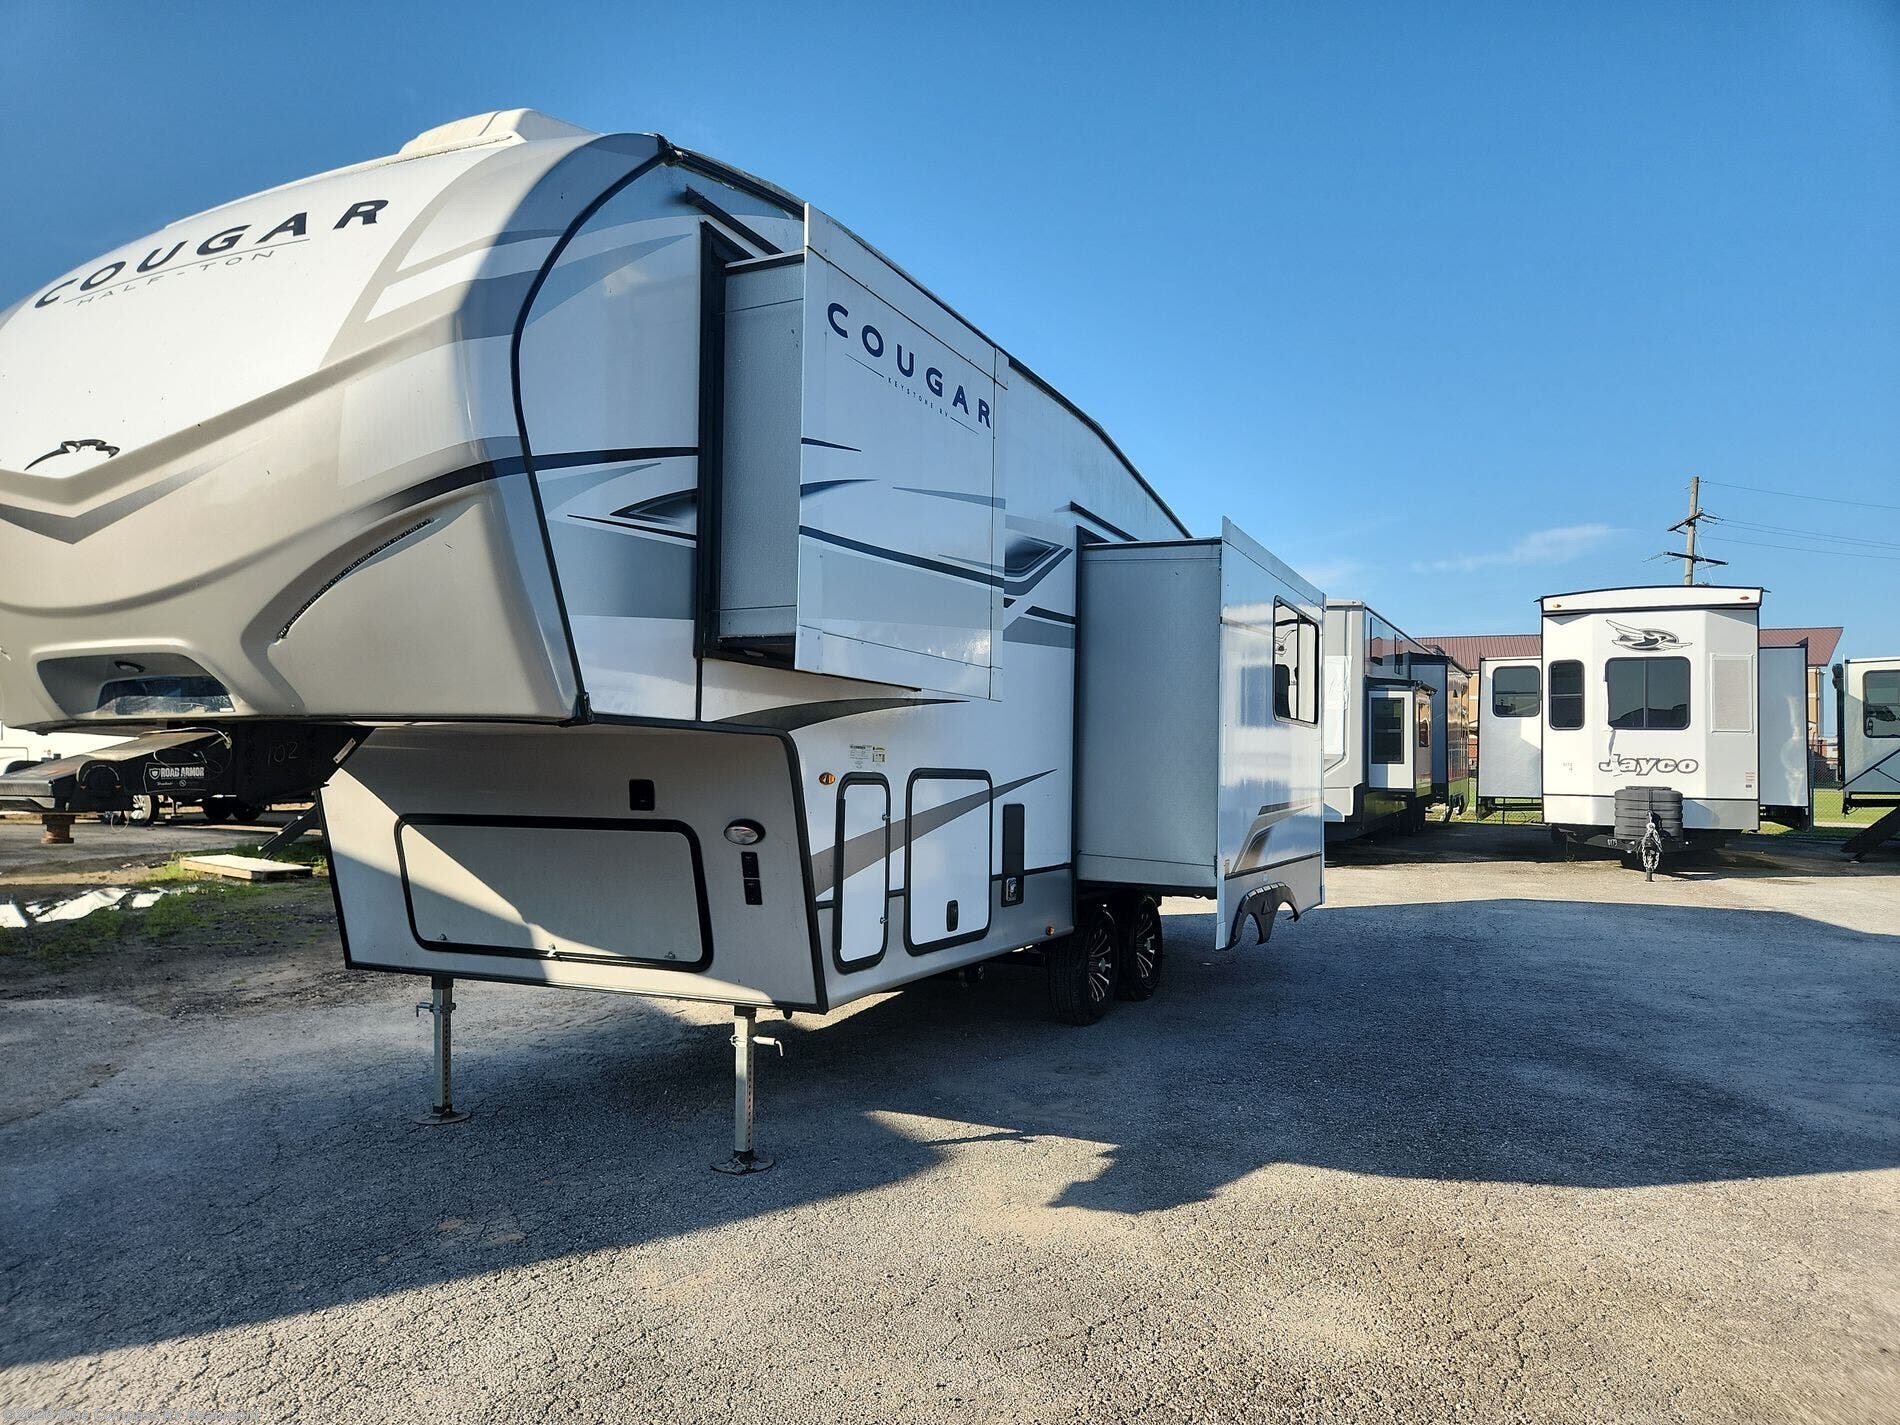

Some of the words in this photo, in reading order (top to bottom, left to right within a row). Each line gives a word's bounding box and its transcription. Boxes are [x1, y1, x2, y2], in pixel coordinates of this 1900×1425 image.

[34, 199, 389, 309] COUGAR
[77, 250, 274, 307] HALF-TON
[827, 302, 992, 429] COUGAR
[888, 377, 933, 409] KEYSTONE
[267, 741, 299, 766] 102
[1598, 753, 1699, 777] Jayco
[161, 767, 180, 778] ROAD
[181, 767, 205, 777] ARMOR
